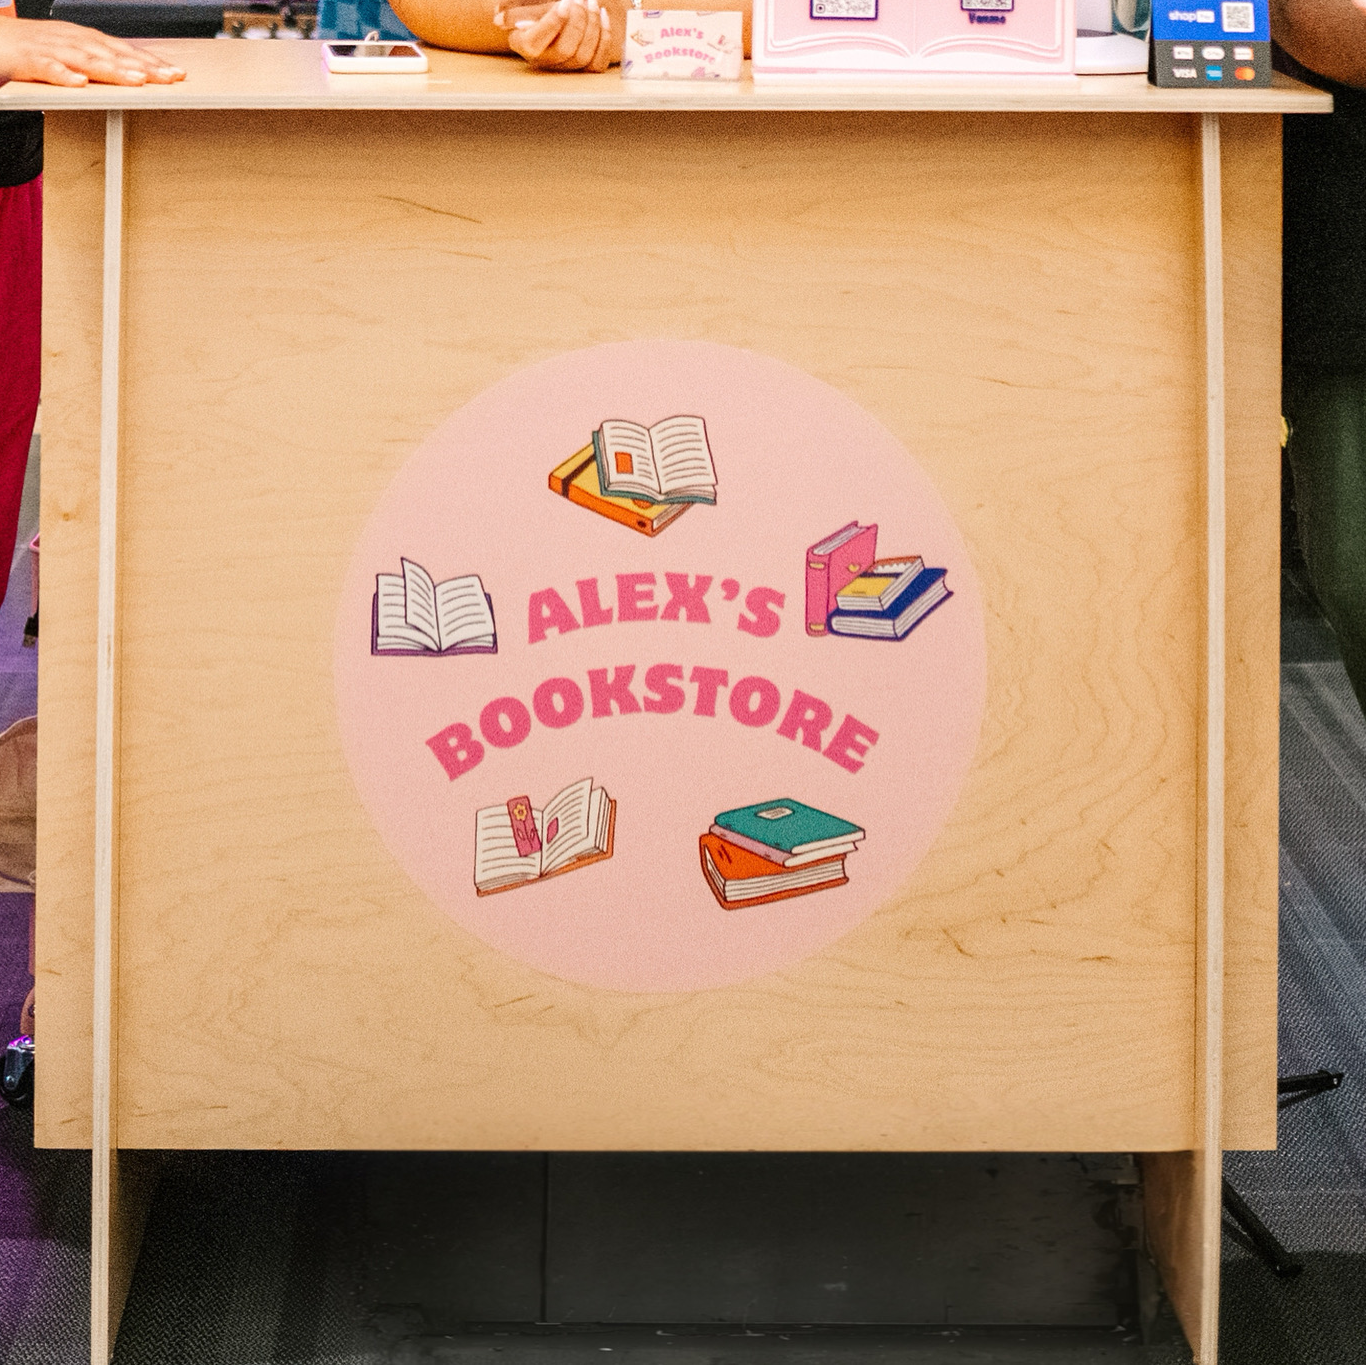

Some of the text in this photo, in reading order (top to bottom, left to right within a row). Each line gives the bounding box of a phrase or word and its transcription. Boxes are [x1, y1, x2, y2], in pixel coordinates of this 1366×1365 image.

[1168, 10, 1196, 23] shop
[660, 27, 704, 41] Alex's
[644, 45, 716, 64] Bookstore
[526, 572, 786, 644] ALEX'S
[425, 663, 881, 782] BOOKSTORE
